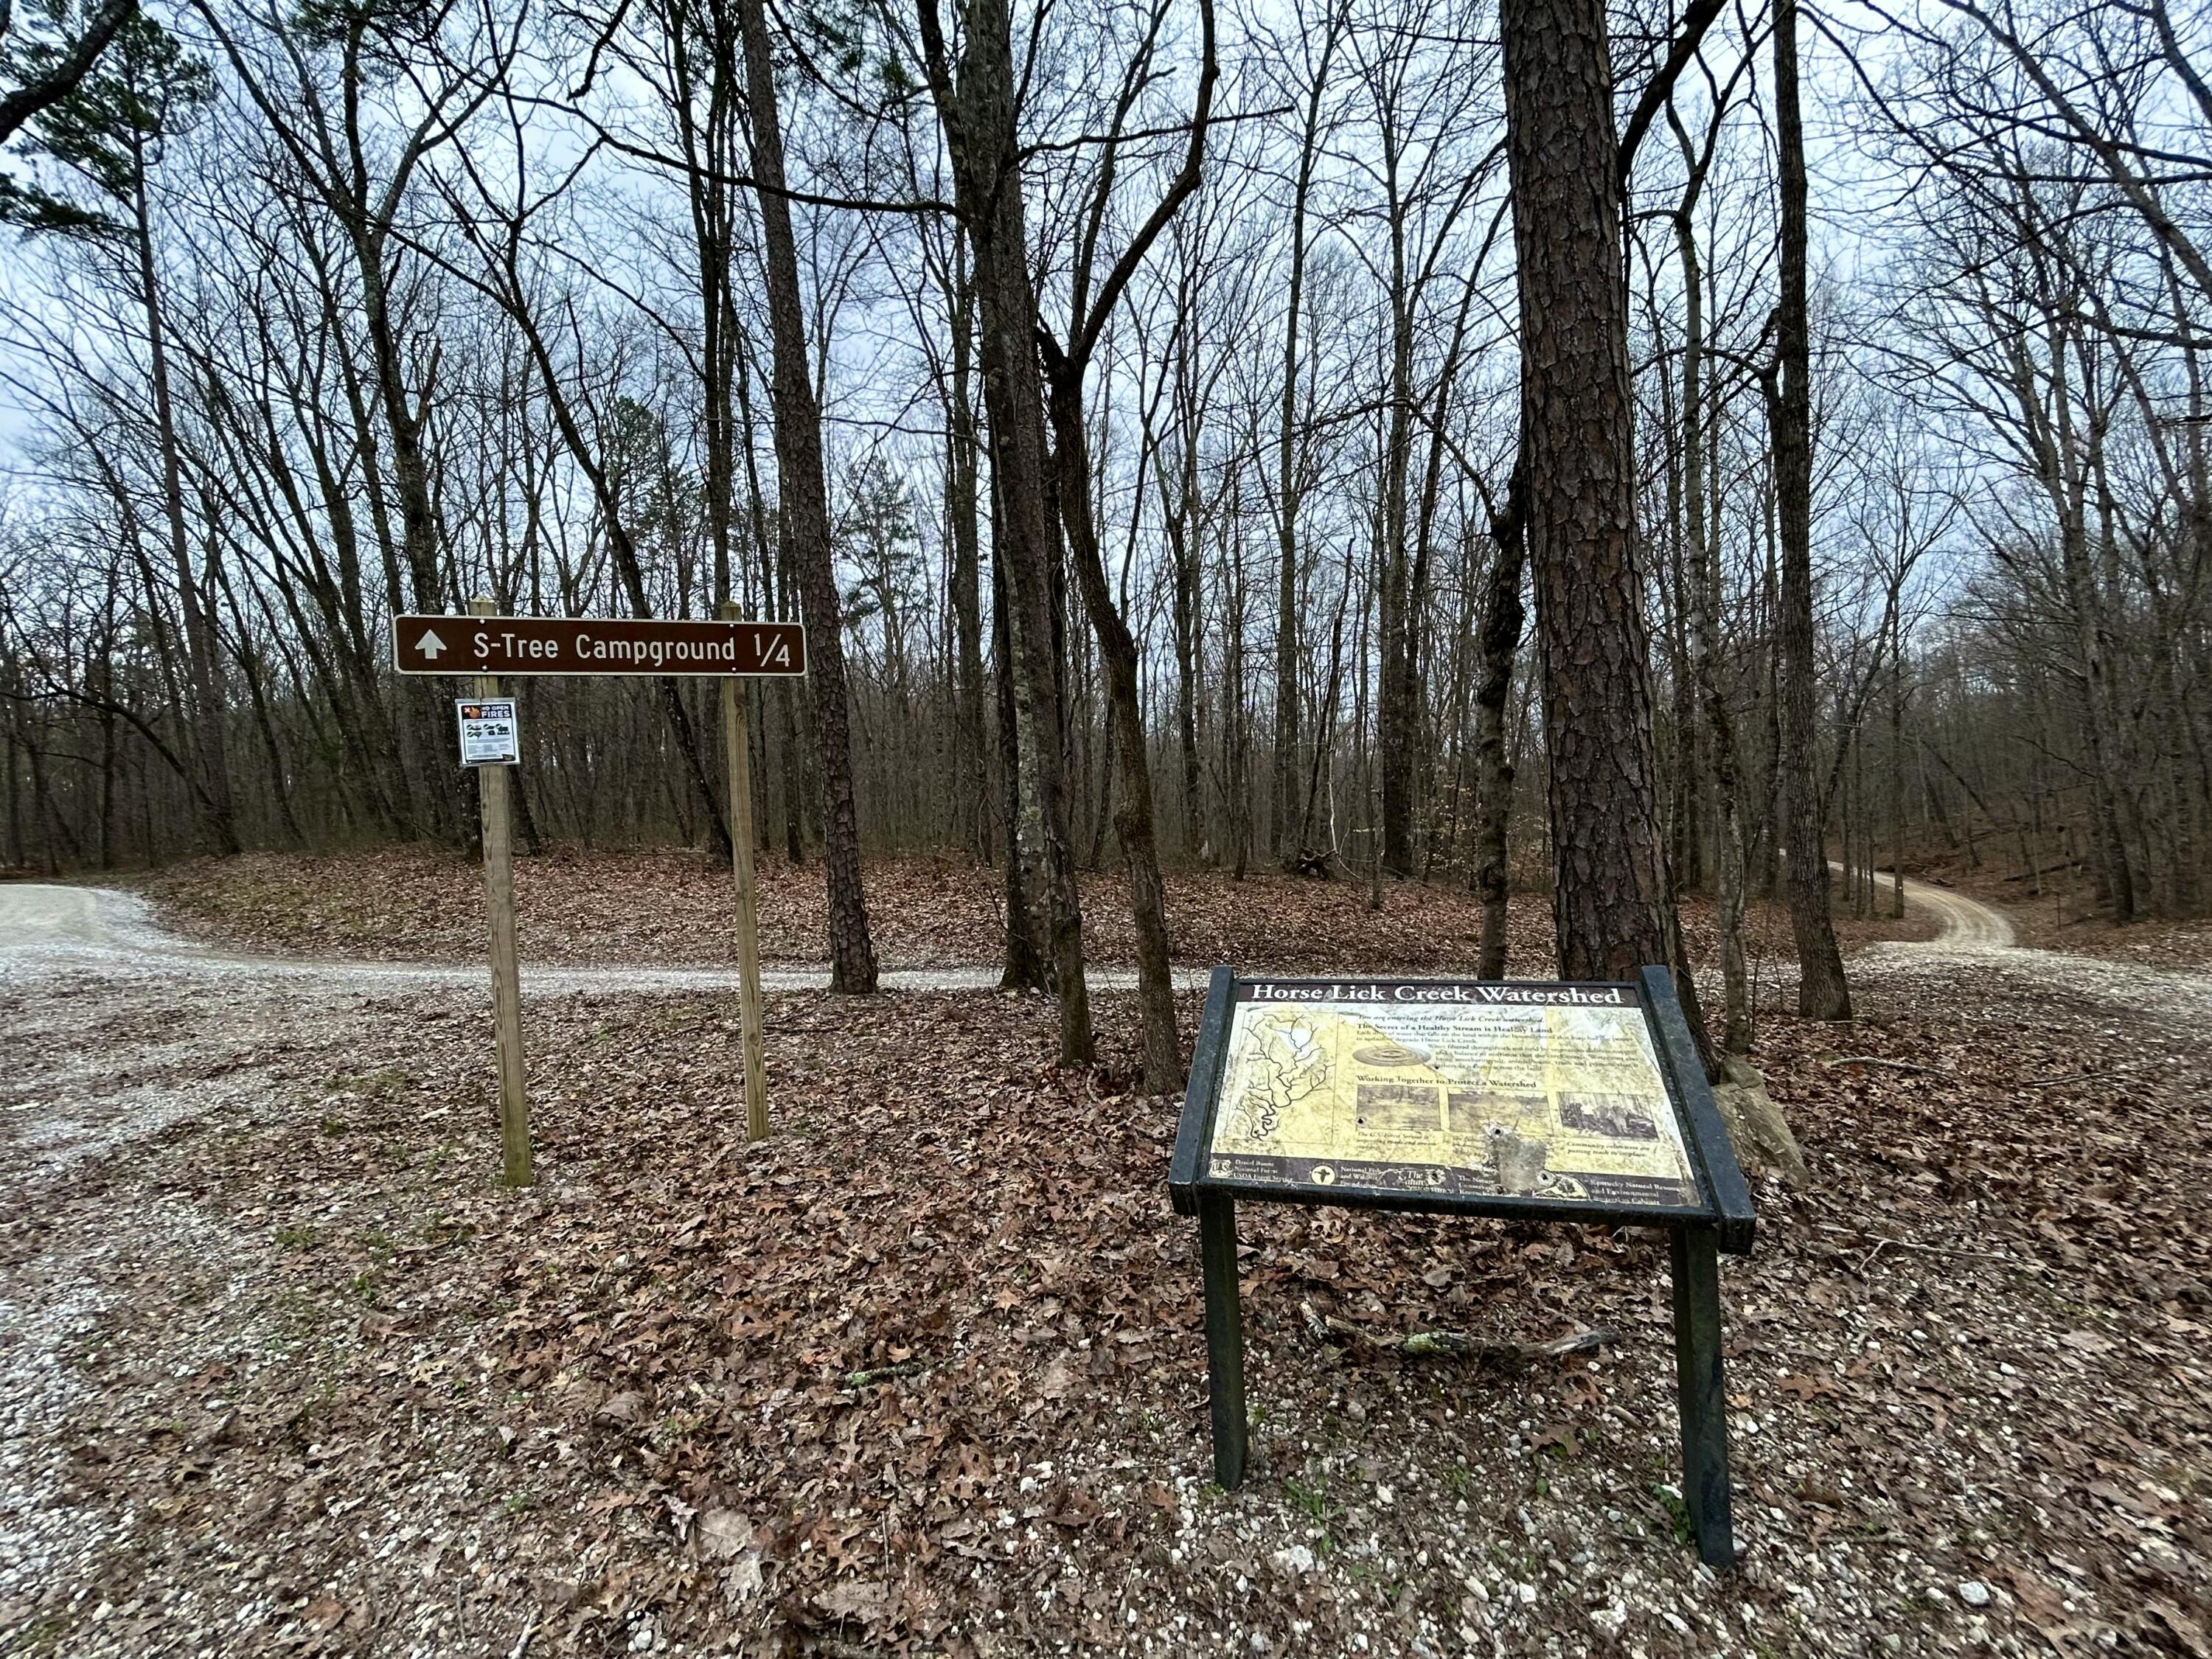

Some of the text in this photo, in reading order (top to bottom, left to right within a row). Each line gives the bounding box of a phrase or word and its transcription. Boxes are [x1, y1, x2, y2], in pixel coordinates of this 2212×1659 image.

[474, 633, 790, 667] S-Tree Campground 1/4
[1251, 984, 1624, 1004] Horse Lick Creek Watershed
[1397, 1076, 1433, 1084] Together
[1407, 1170, 1423, 1178] The
[1590, 1180, 1623, 1188] Kentucky
[1607, 1189, 1659, 1197] Environmental
